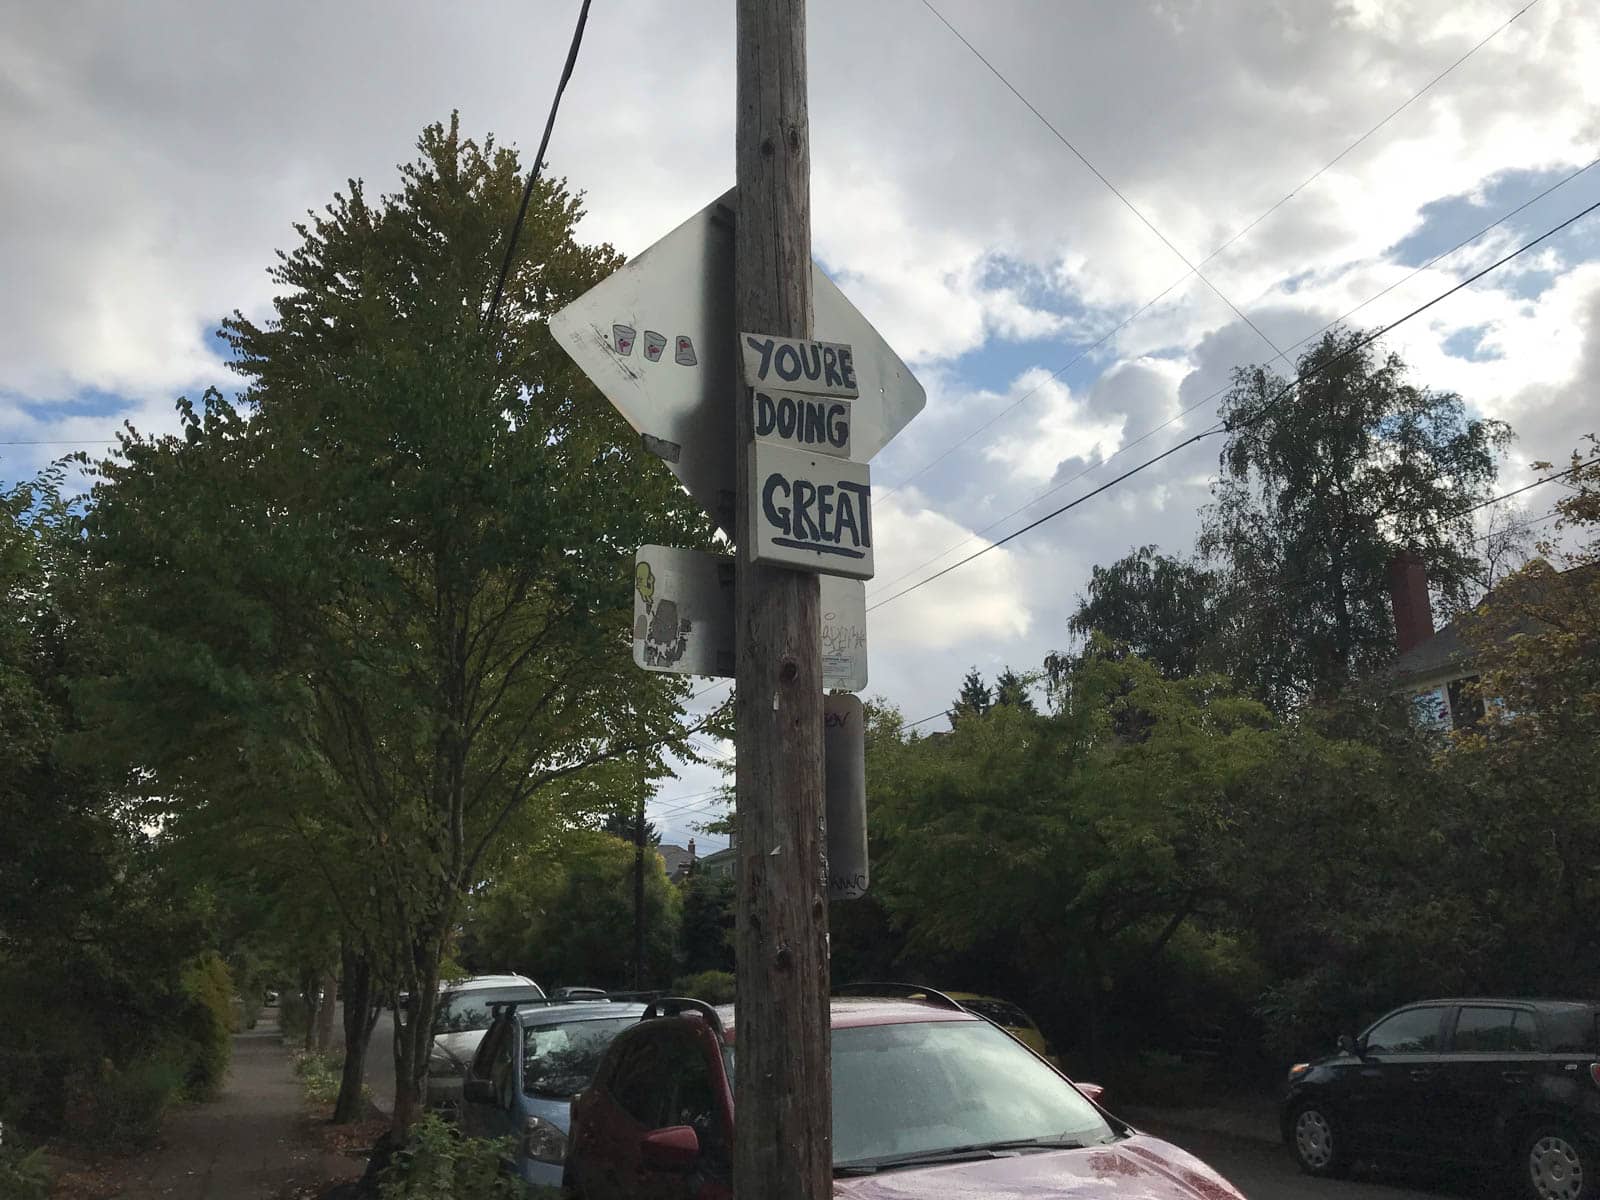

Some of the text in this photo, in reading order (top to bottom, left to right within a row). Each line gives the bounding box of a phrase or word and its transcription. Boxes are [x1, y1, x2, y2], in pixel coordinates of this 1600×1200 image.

[747, 336, 857, 389] YOU'RE
[756, 392, 849, 448] DOING
[762, 473, 871, 548] GREAT
